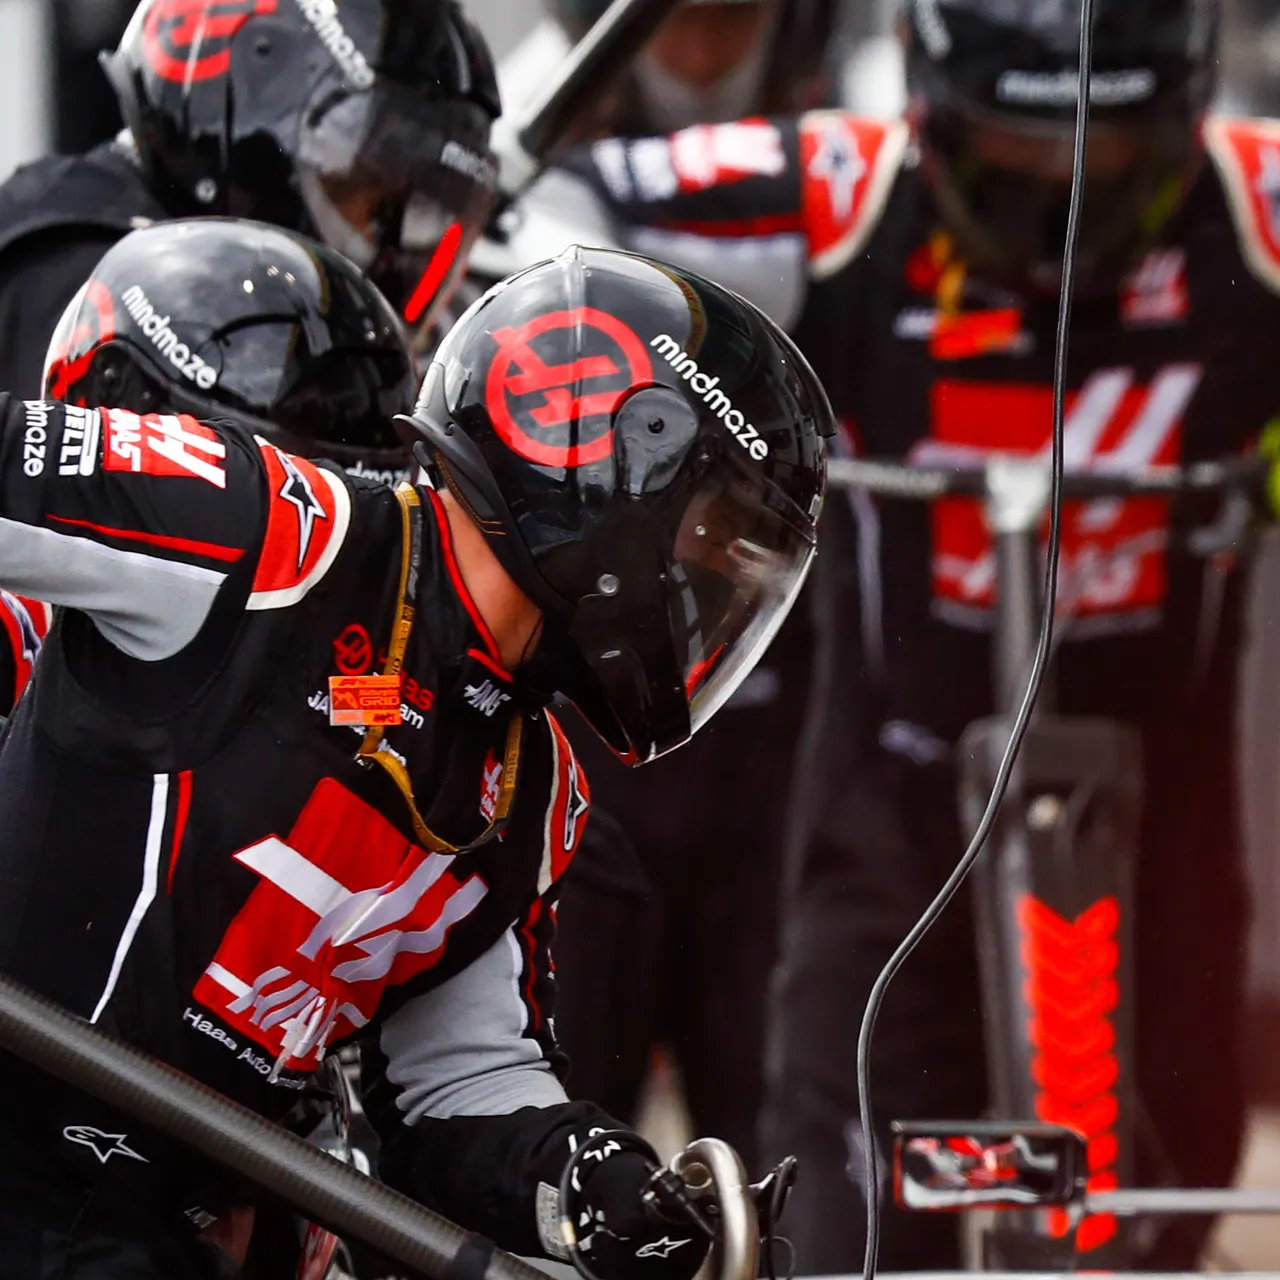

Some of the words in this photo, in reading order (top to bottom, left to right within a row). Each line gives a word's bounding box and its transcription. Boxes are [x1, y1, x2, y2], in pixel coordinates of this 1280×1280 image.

[122, 285, 218, 389] mindmaze
[650, 333, 768, 461] mindmaze
[22, 400, 55, 478] dmaze
[58, 403, 102, 477] RELLI
[182, 1007, 238, 1051] Haas
